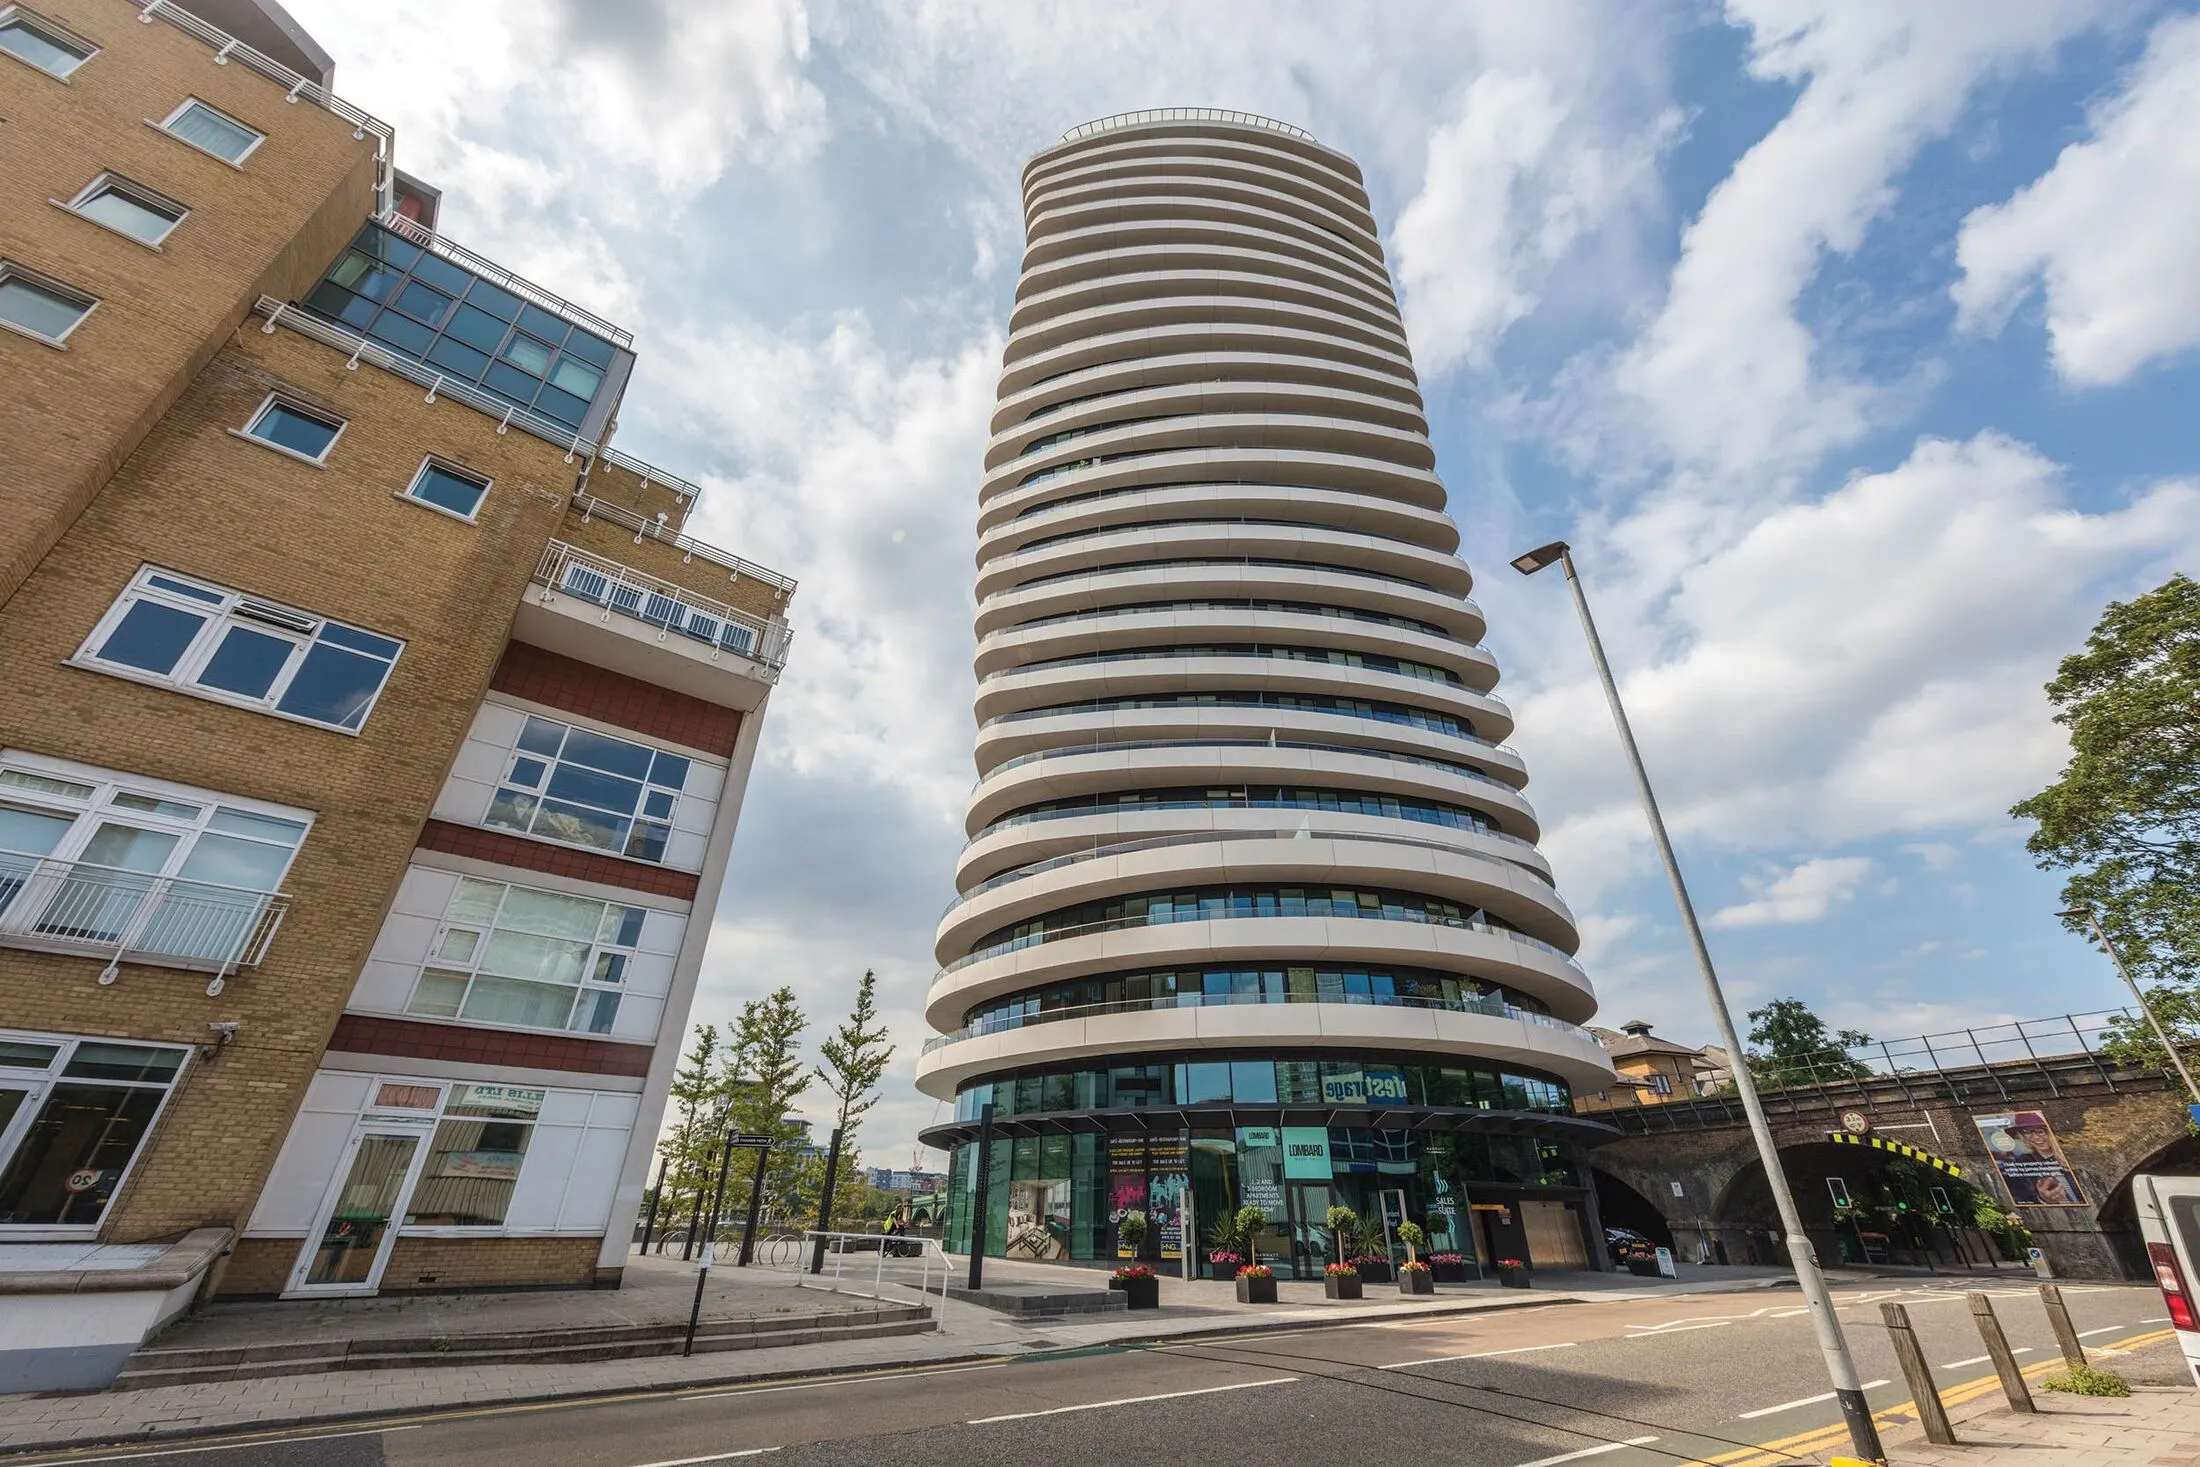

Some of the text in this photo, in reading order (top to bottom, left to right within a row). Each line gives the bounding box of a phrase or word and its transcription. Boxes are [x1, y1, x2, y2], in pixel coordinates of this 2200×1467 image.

[1288, 1144, 1324, 1157] LOMBARD
[1246, 1192, 1280, 1200] APARTMENTS
[1436, 1197, 1455, 1205] SALES
[1438, 1207, 1456, 1215] SUITE
